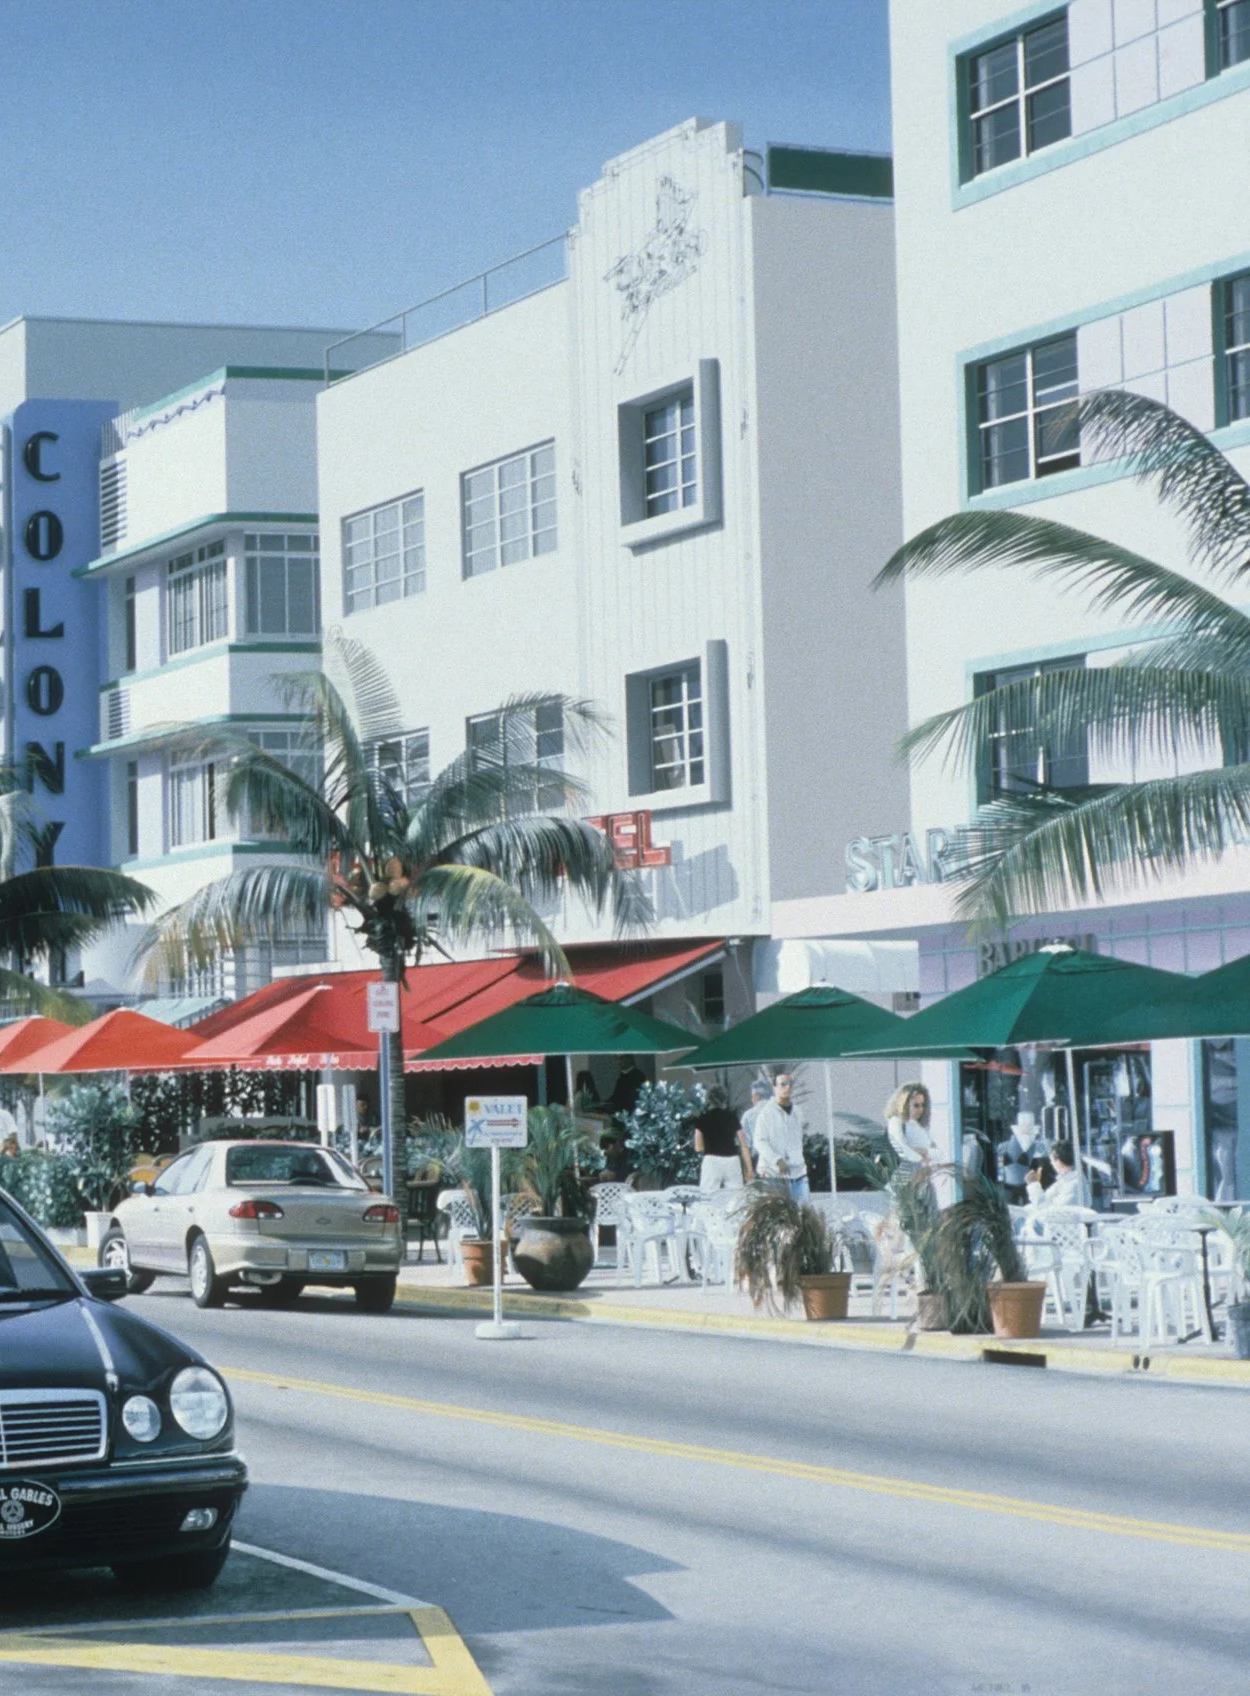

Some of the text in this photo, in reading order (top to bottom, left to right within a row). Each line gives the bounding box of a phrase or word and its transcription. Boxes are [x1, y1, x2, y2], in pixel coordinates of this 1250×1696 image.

[23, 430, 66, 870] COLONY
[484, 1103, 522, 1114] VALET
[10, 1487, 54, 1507] GABLES
